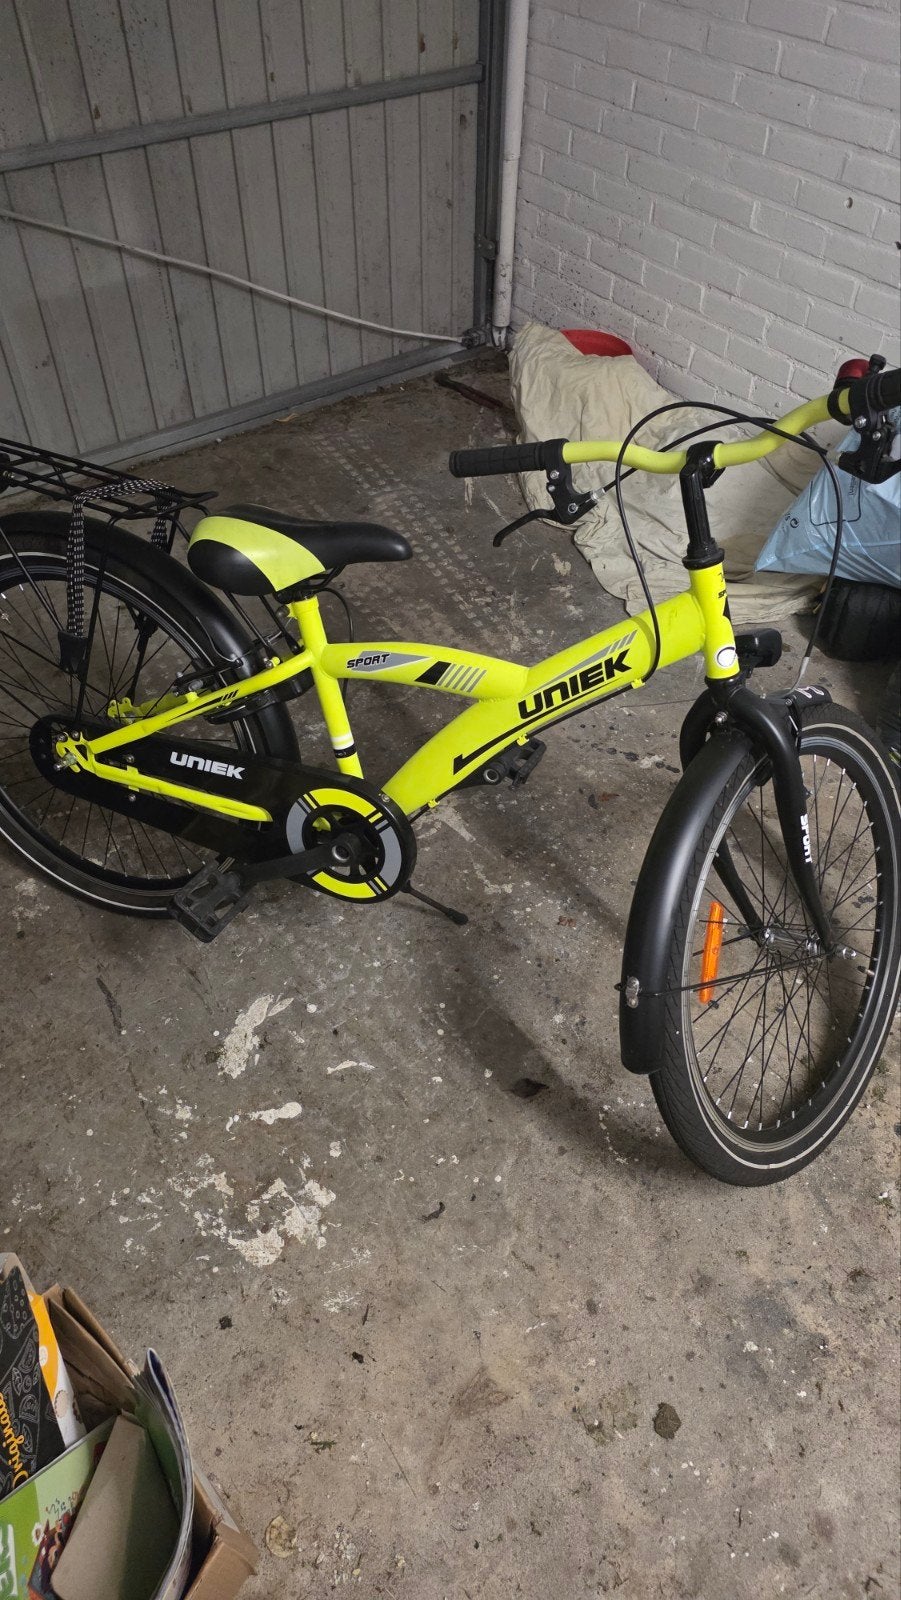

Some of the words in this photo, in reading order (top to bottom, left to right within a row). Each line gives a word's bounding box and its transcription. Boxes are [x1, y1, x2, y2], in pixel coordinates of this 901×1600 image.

[346, 653, 391, 669] SPORT
[518, 648, 632, 720] UNIEK
[169, 751, 246, 780] UNIEK
[800, 813, 813, 864] SPORT
